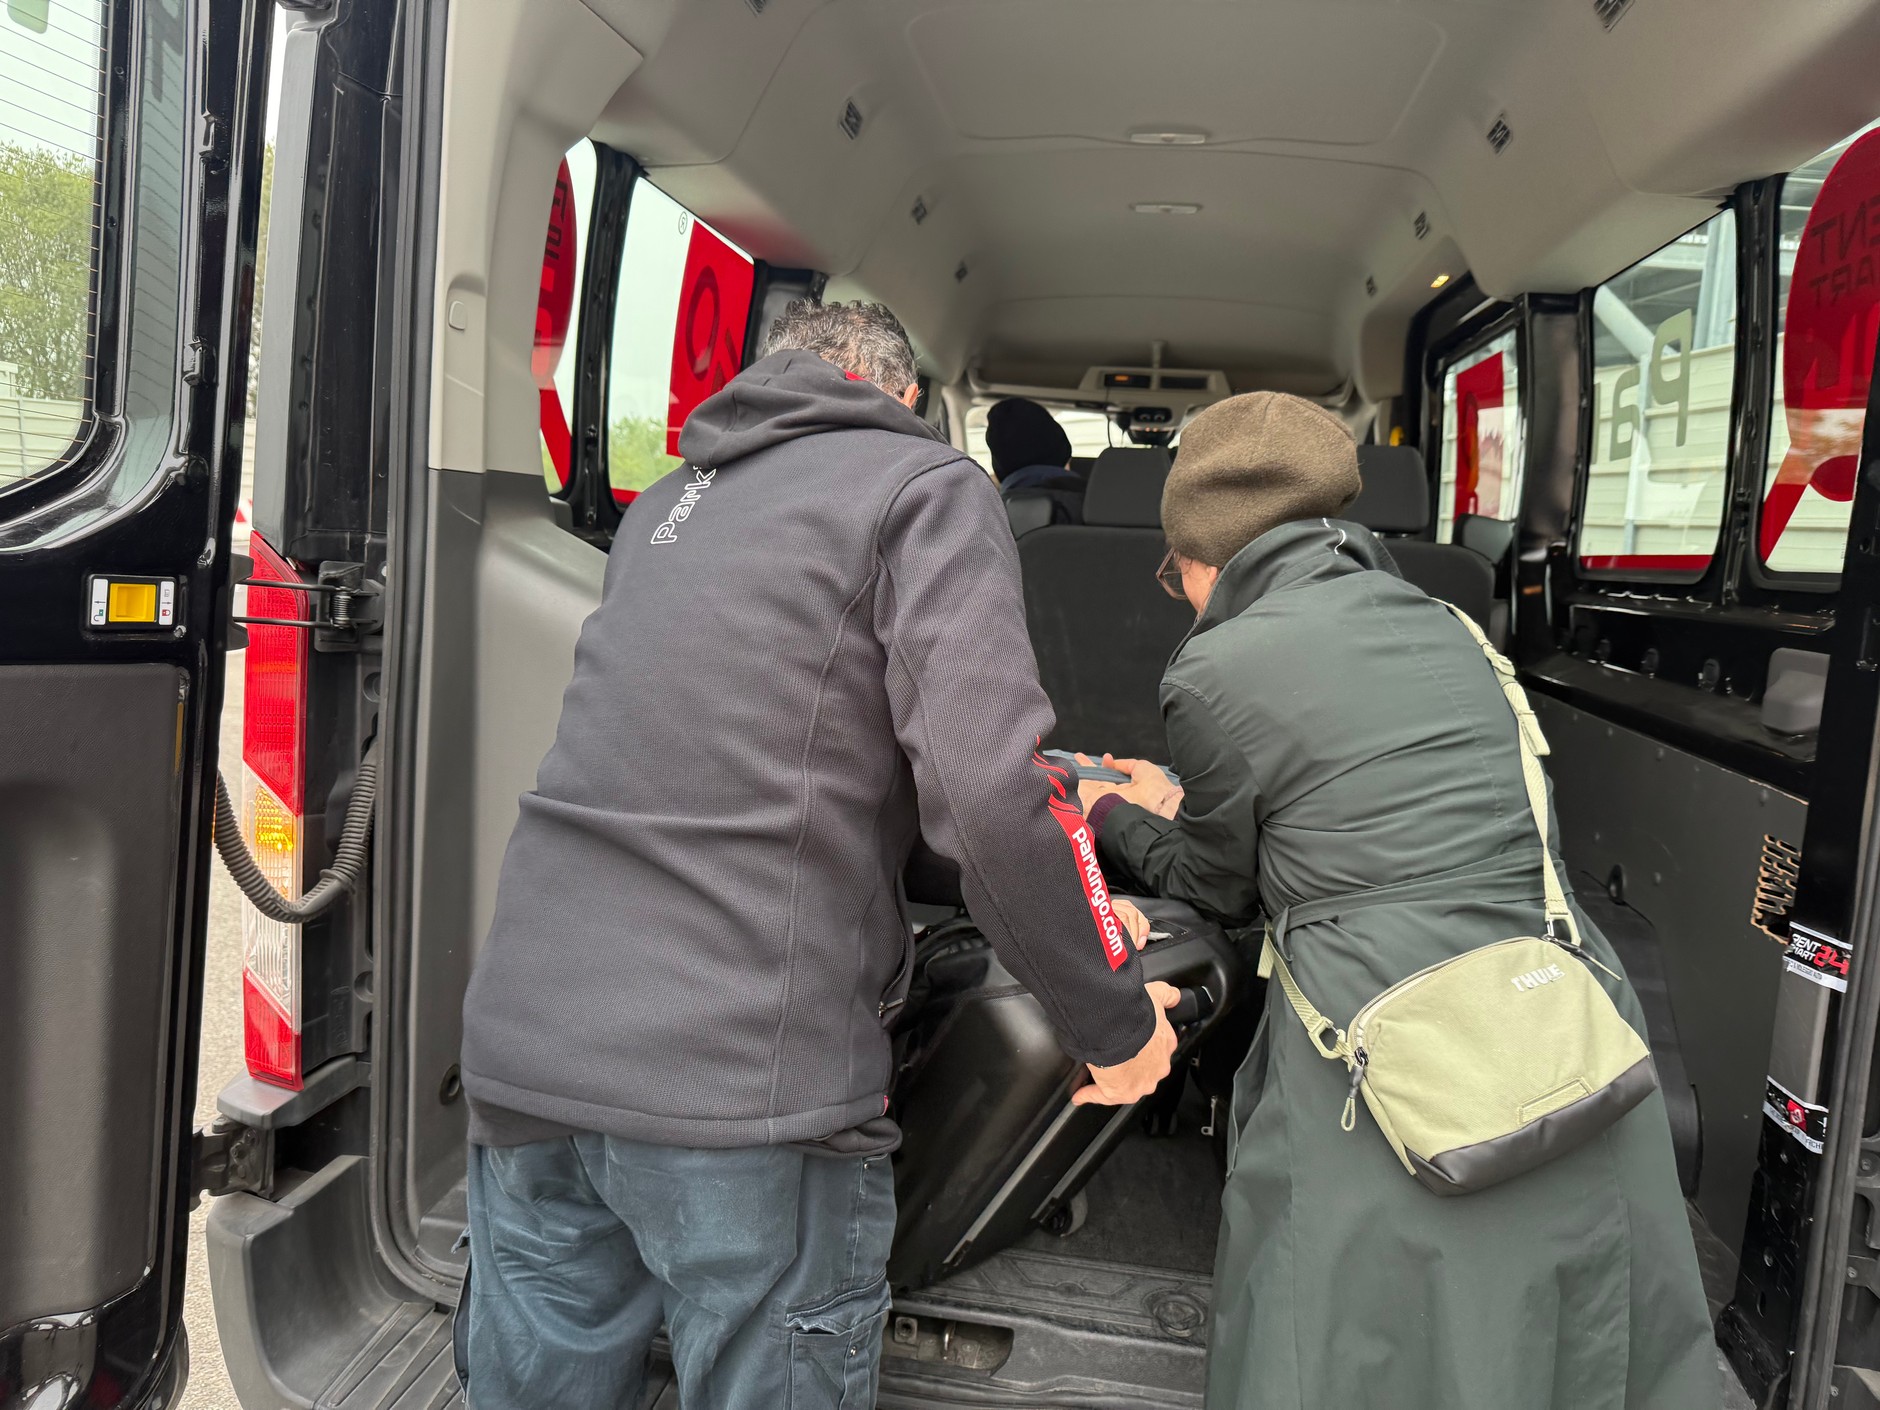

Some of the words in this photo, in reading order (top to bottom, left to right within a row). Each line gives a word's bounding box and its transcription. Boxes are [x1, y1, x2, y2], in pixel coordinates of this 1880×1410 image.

[1072, 826, 1123, 957] parkingo.com
[1813, 945, 1849, 976] 24
[1511, 963, 1565, 992] THULE
